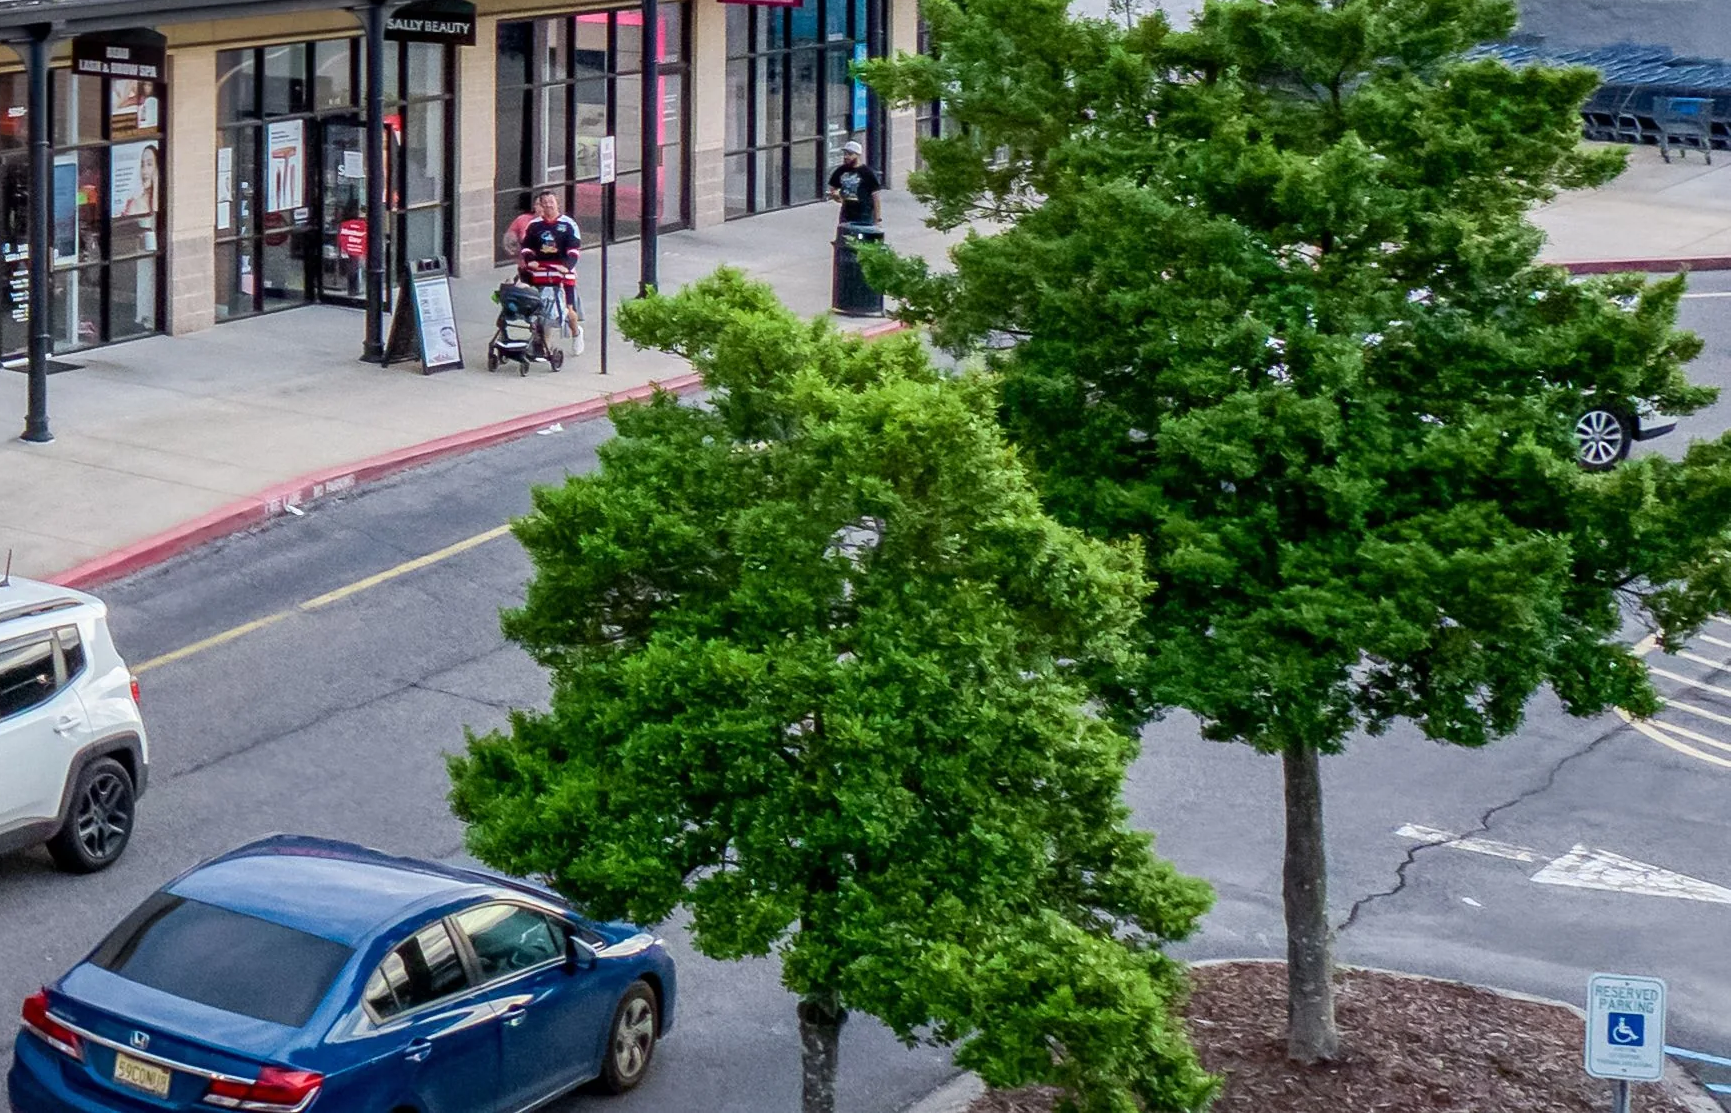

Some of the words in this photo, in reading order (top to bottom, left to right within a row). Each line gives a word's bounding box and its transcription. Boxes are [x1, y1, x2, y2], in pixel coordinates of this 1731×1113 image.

[386, 18, 424, 31] SALLY
[424, 20, 471, 35] BEAUTY
[1595, 985, 1659, 1001] RESERVED
[1599, 998, 1655, 1014] PARKING
